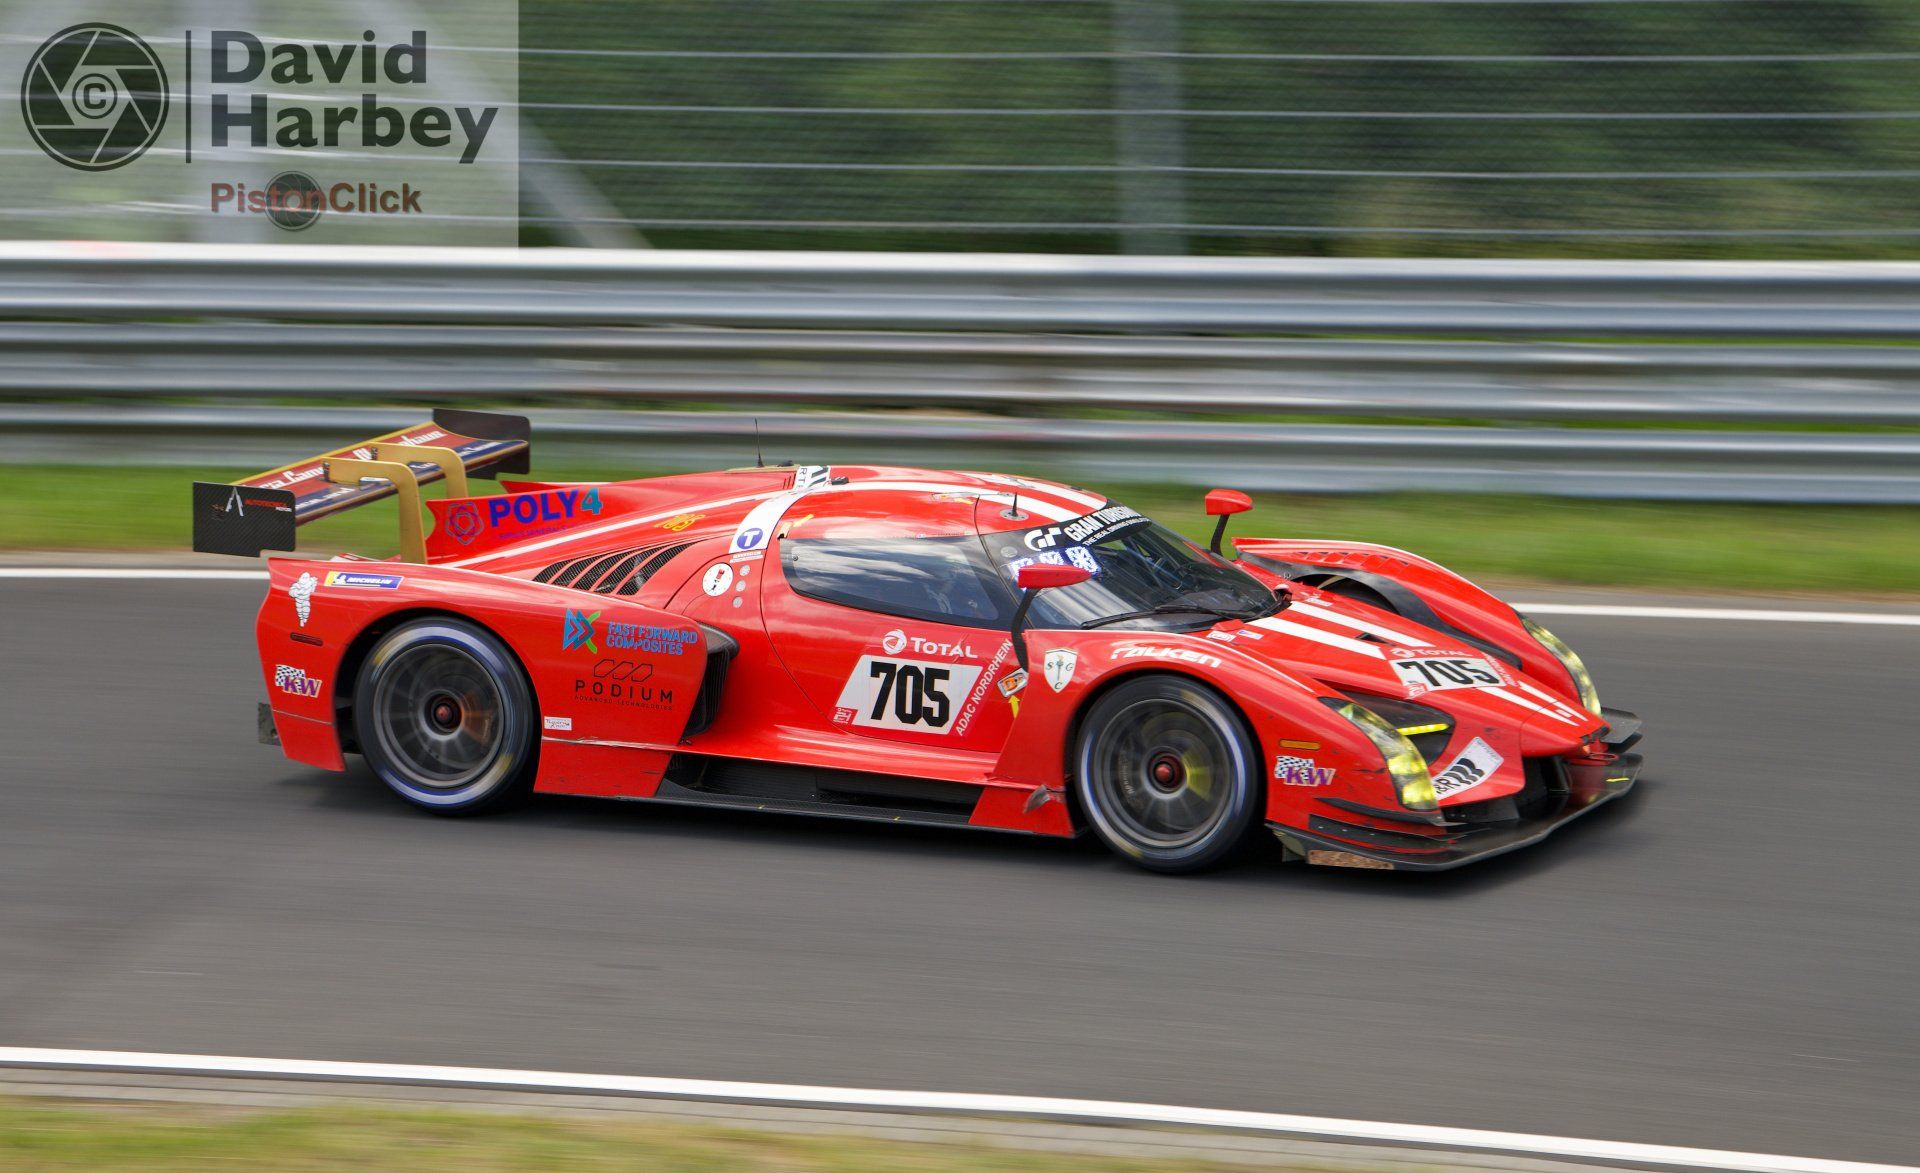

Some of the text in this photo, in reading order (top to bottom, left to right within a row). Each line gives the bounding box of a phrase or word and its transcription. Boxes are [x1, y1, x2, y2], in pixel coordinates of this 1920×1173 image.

[488, 487, 603, 528] POLY4
[1064, 513, 1105, 541] GRAN
[346, 577, 393, 585] MICHELIN
[607, 621, 698, 644] FAST FORWARD
[606, 634, 683, 655] COMPOSITES
[910, 637, 978, 658] TOTAL
[1396, 660, 1500, 687] 705
[283, 675, 322, 698] KW
[575, 680, 673, 704] PODIUM
[870, 661, 950, 727] 705
[955, 638, 1013, 737] ADAC NORDRHEIN
[1284, 766, 1336, 786] KW
